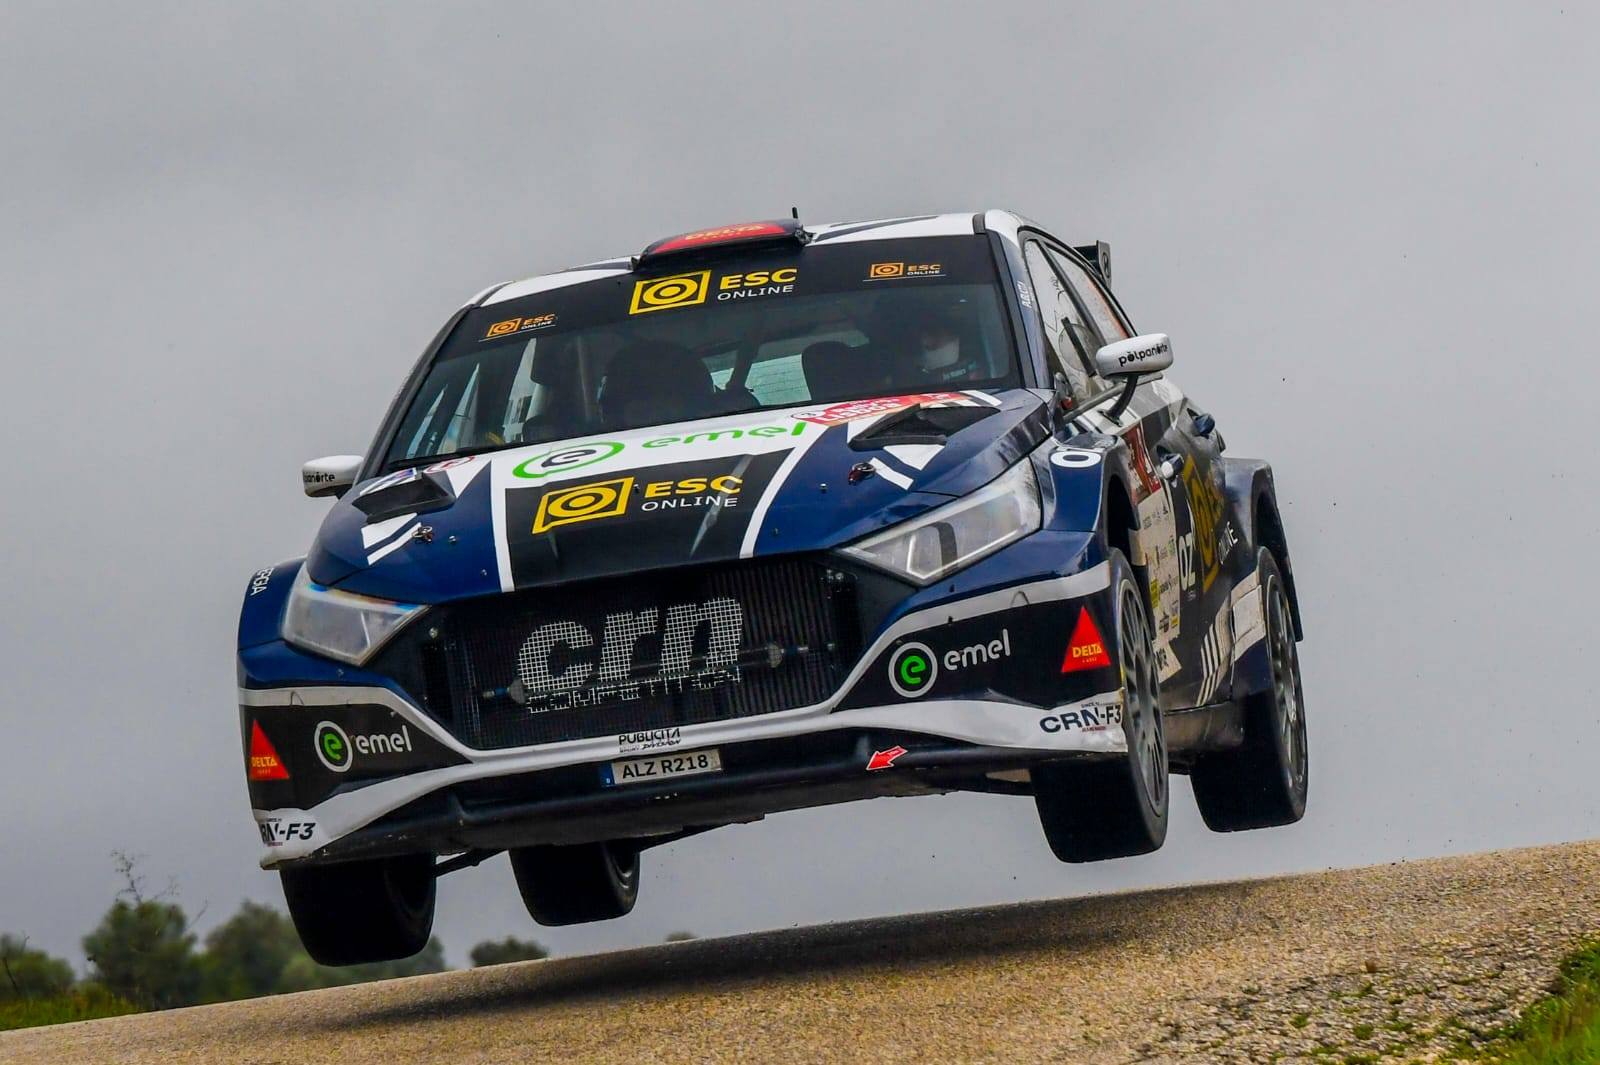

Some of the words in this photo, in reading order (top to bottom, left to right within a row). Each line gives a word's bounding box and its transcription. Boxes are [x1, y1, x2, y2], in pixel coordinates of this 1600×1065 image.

[719, 268, 797, 291] ESC
[908, 264, 941, 272] ESC
[717, 284, 794, 300] ONLINE
[521, 320, 552, 330] ONLINE
[523, 313, 555, 325] ESC
[641, 422, 807, 449] emel
[644, 475, 743, 499] ESC
[641, 495, 738, 512] ONLINE
[518, 597, 743, 693] crn
[943, 628, 1011, 672] emel
[1072, 643, 1102, 658] DELTA
[1040, 704, 1122, 734] CRN-F3
[355, 725, 413, 755] emel
[622, 761, 657, 779] ALZ
[661, 754, 709, 774] R218
